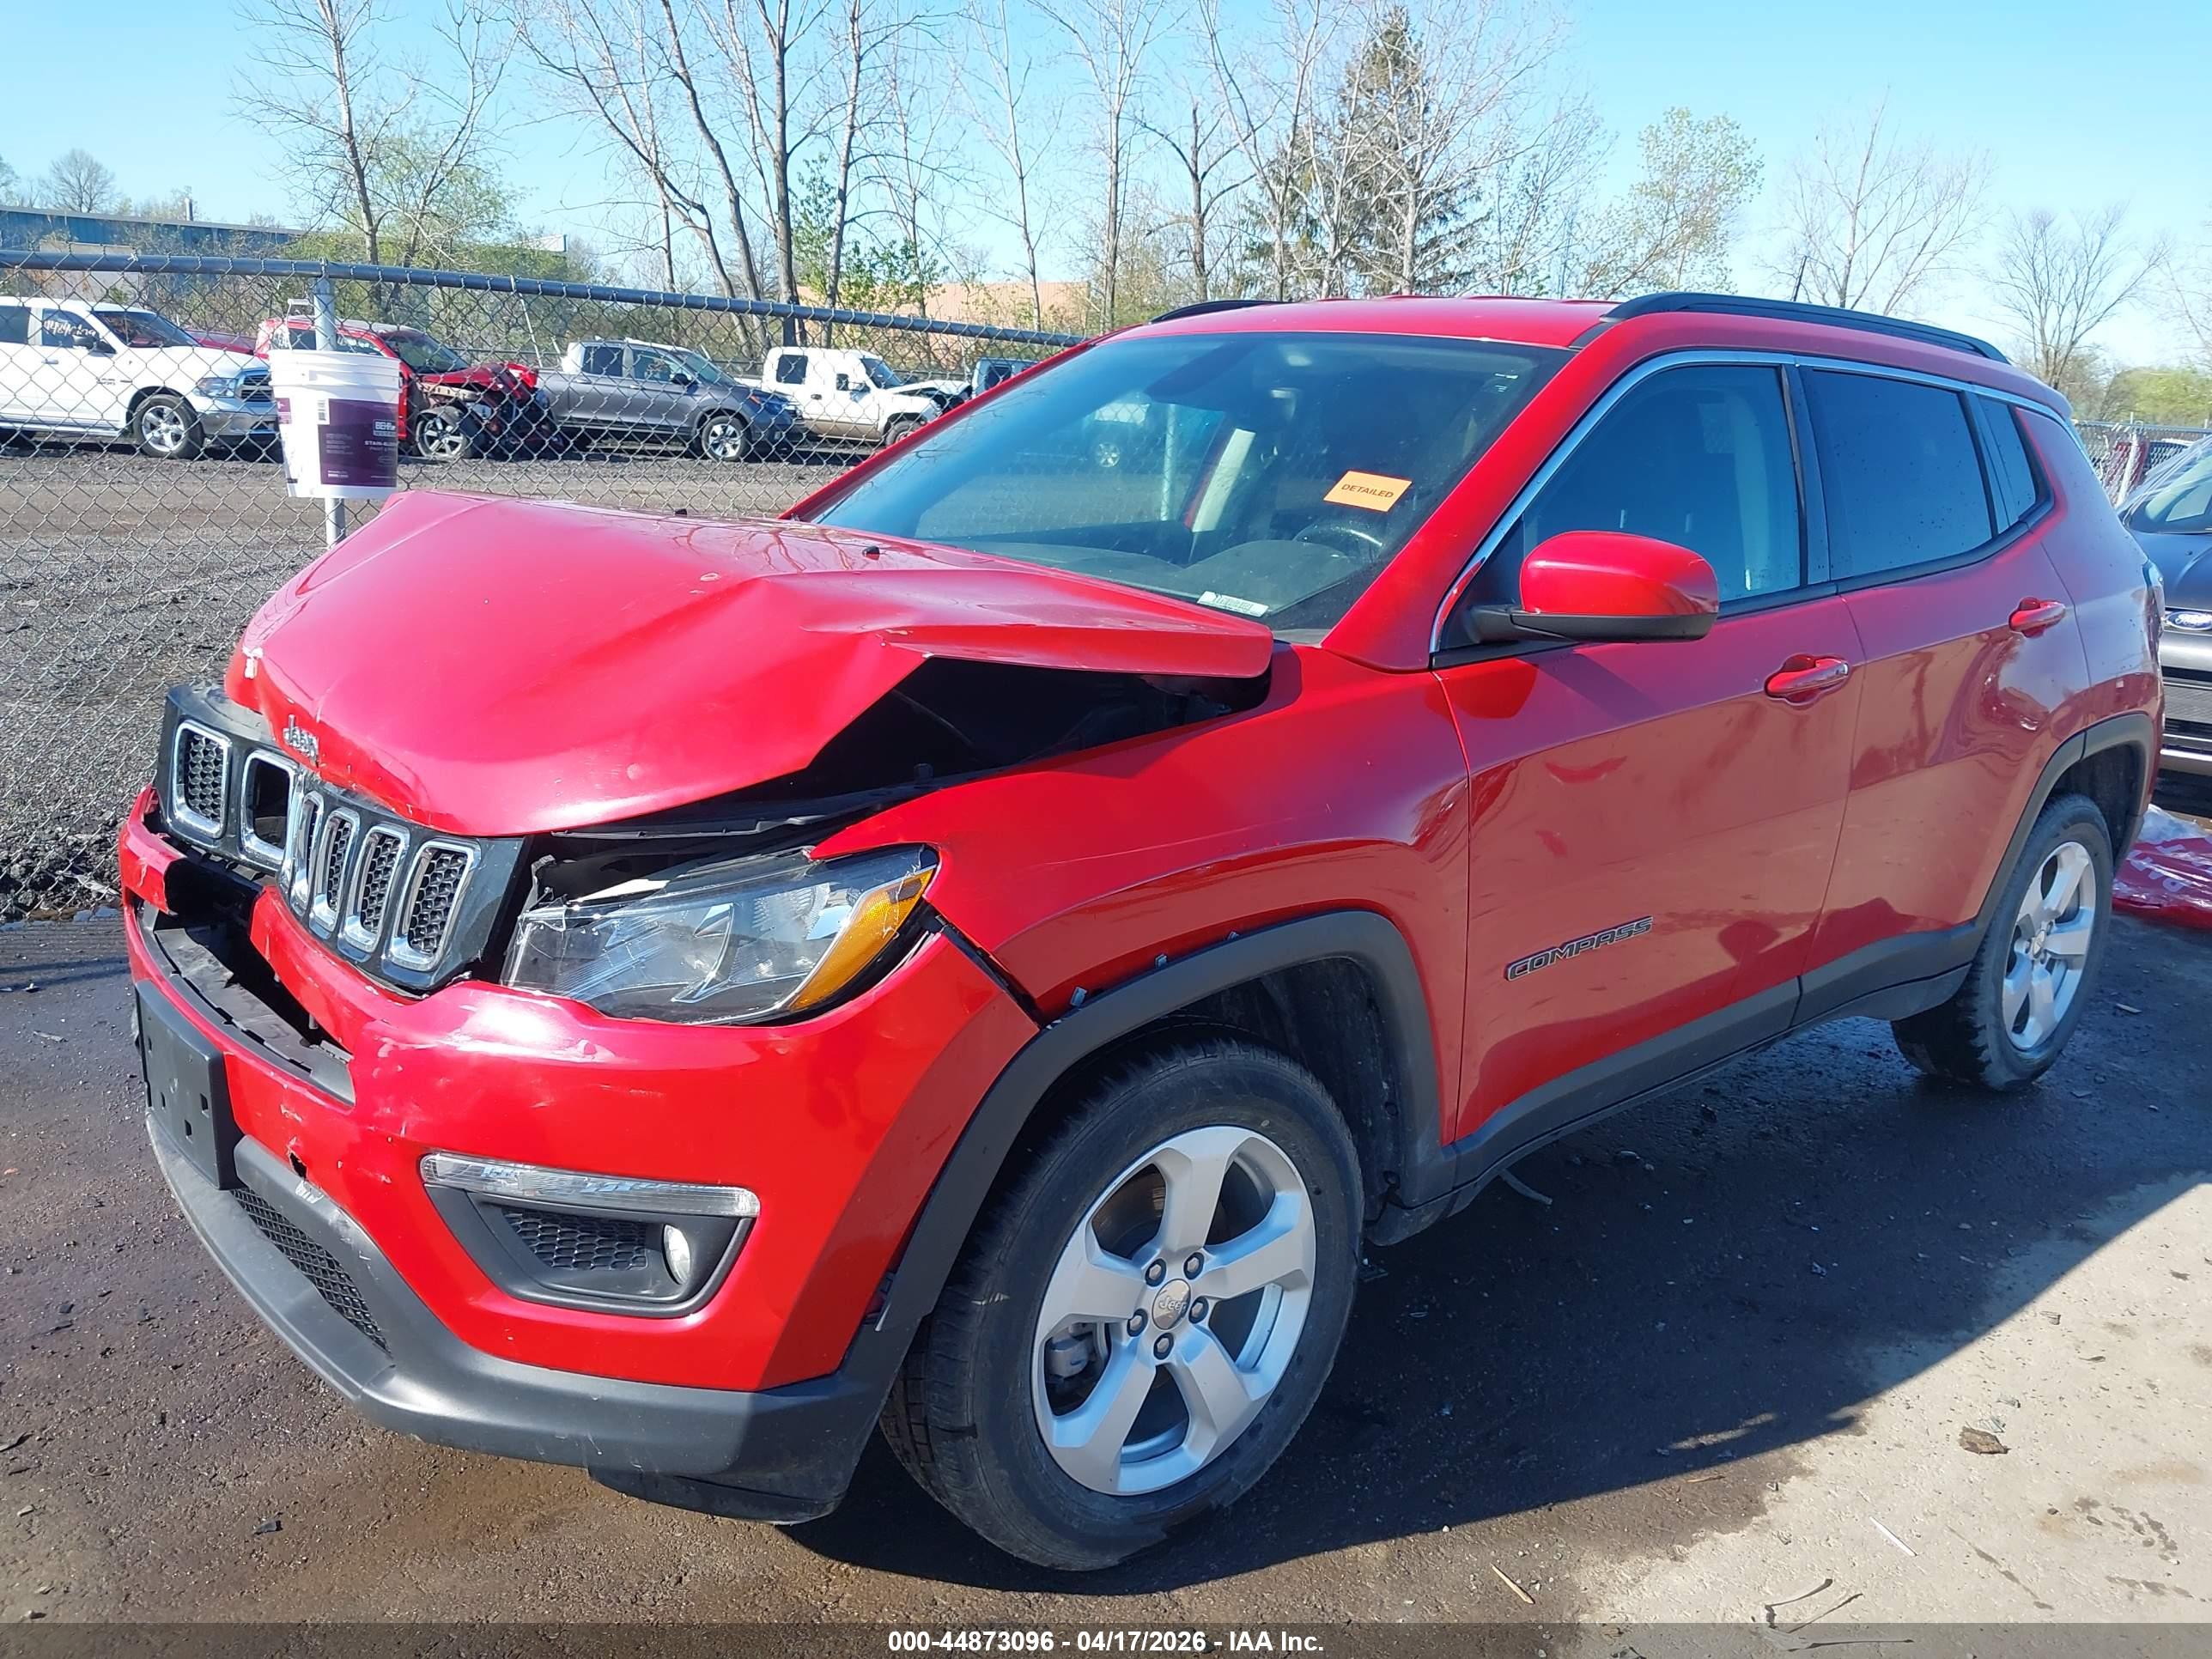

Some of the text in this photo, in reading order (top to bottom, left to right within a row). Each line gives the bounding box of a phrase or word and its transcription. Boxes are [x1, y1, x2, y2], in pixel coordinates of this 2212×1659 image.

[1340, 483, 1395, 499] DETAILED
[1505, 915, 1654, 981] COMPASS
[1158, 1296, 1188, 1315] Jeep
